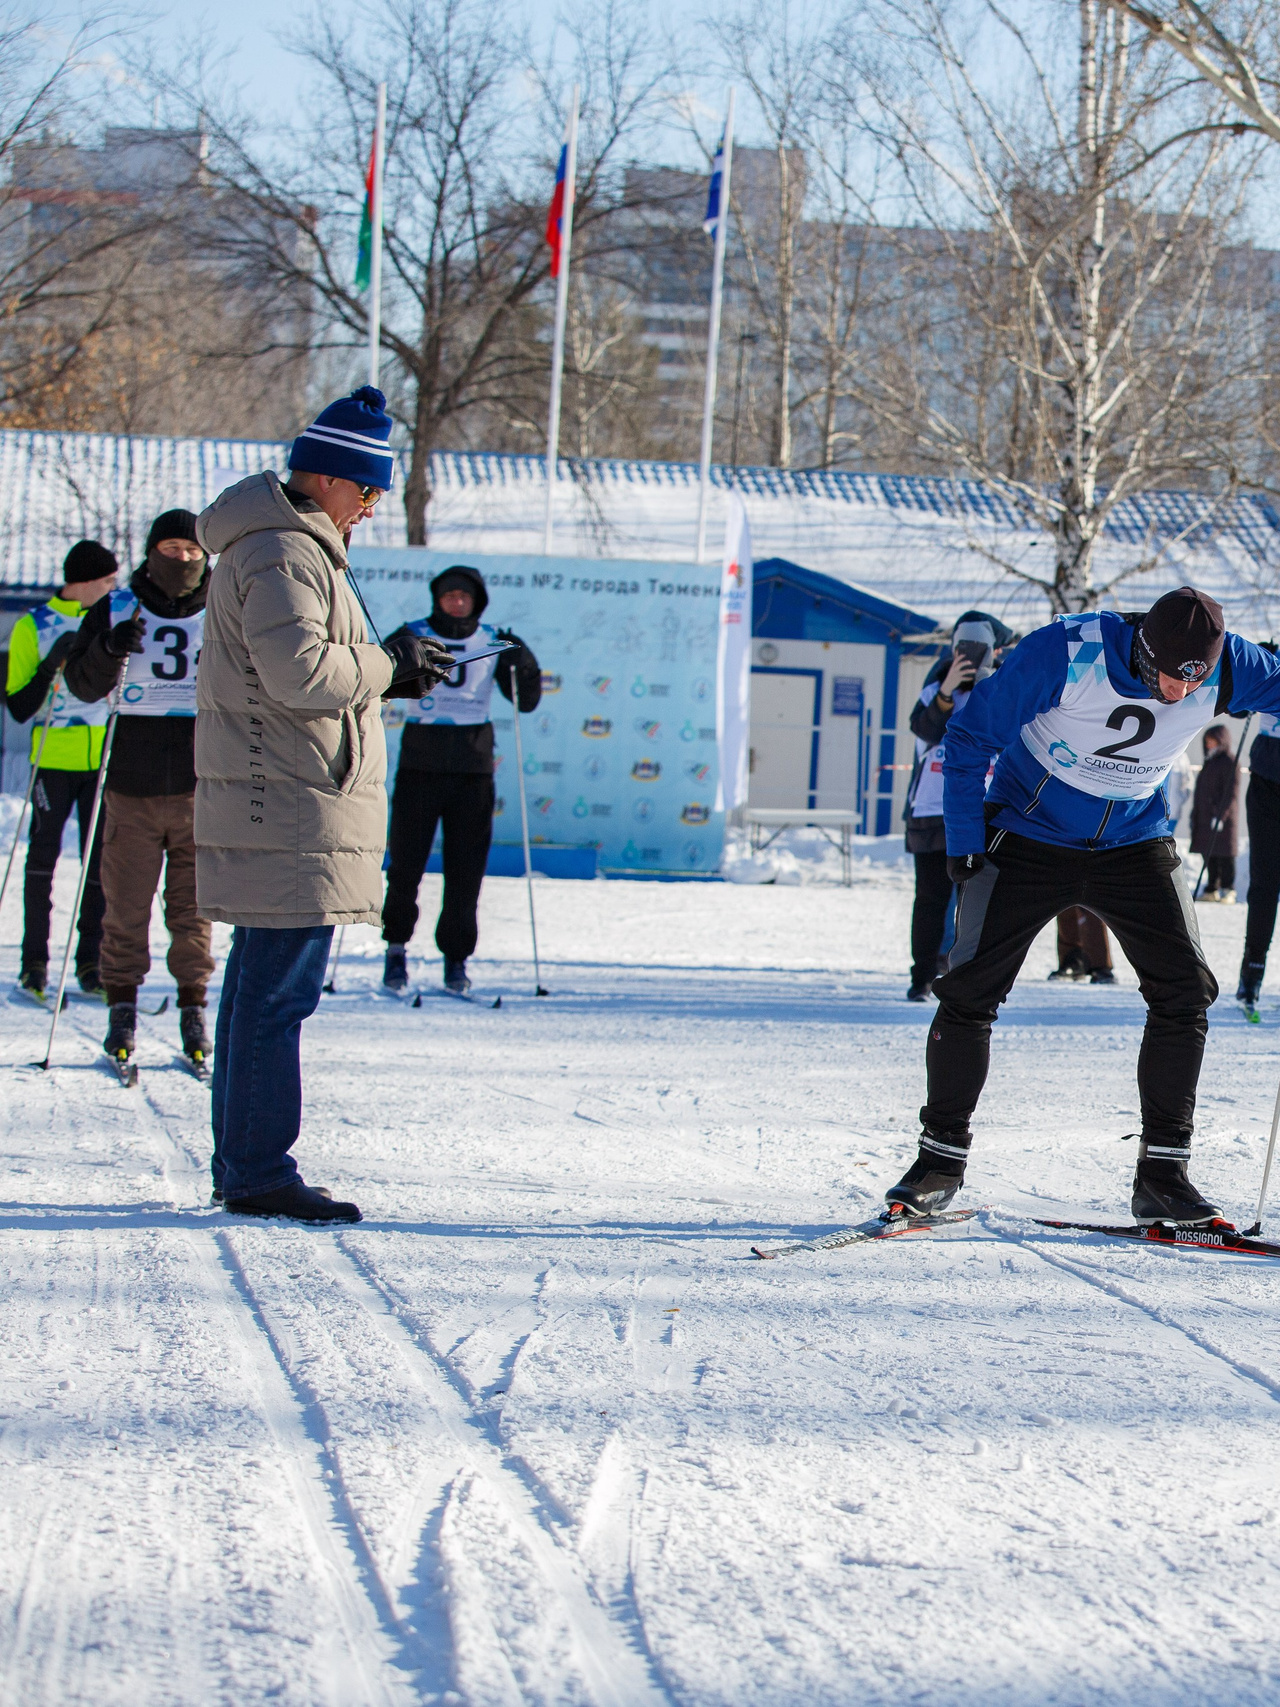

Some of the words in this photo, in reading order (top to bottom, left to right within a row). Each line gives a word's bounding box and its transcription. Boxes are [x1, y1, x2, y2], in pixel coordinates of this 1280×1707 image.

[353, 566, 434, 583] ортивна
[483, 572, 526, 588] кола
[531, 573, 565, 590] №2
[570, 576, 640, 596] города
[1092, 704, 1156, 763] 2
[249, 716, 266, 824] ATHLETES
[1084, 756, 1153, 775] СДЮСШОР
